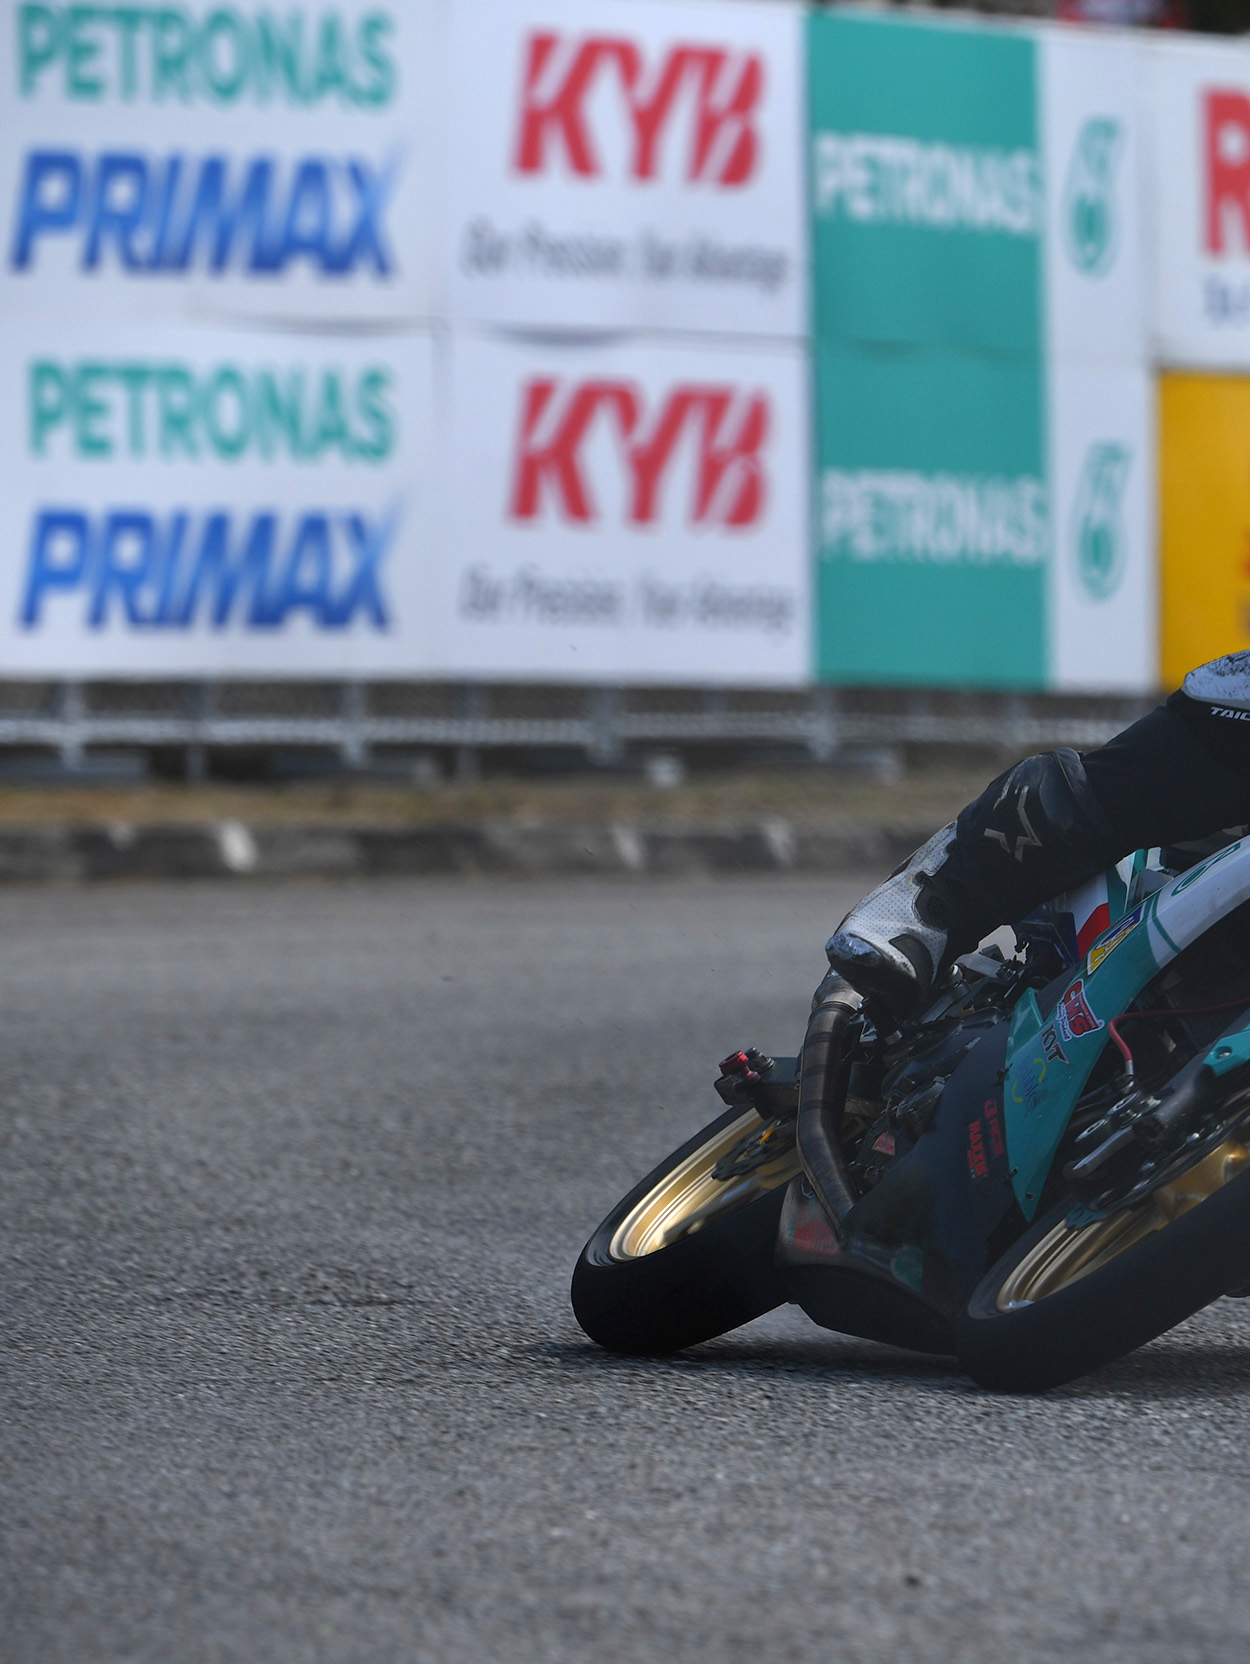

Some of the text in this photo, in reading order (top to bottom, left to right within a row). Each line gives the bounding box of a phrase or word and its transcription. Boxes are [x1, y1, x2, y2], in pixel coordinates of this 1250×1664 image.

[18, 5, 396, 109] PETRONAS
[512, 31, 767, 189] KYB
[10, 149, 402, 279] PRIMAX
[815, 131, 1040, 234] PETRONAS
[27, 359, 396, 465] PETRONAS
[508, 377, 771, 530] KYB
[818, 467, 1044, 560] PETRONAS
[18, 506, 402, 634] PRIMAX
[1041, 1023, 1069, 1063] KYT
[968, 1120, 988, 1176] MAXXIS
